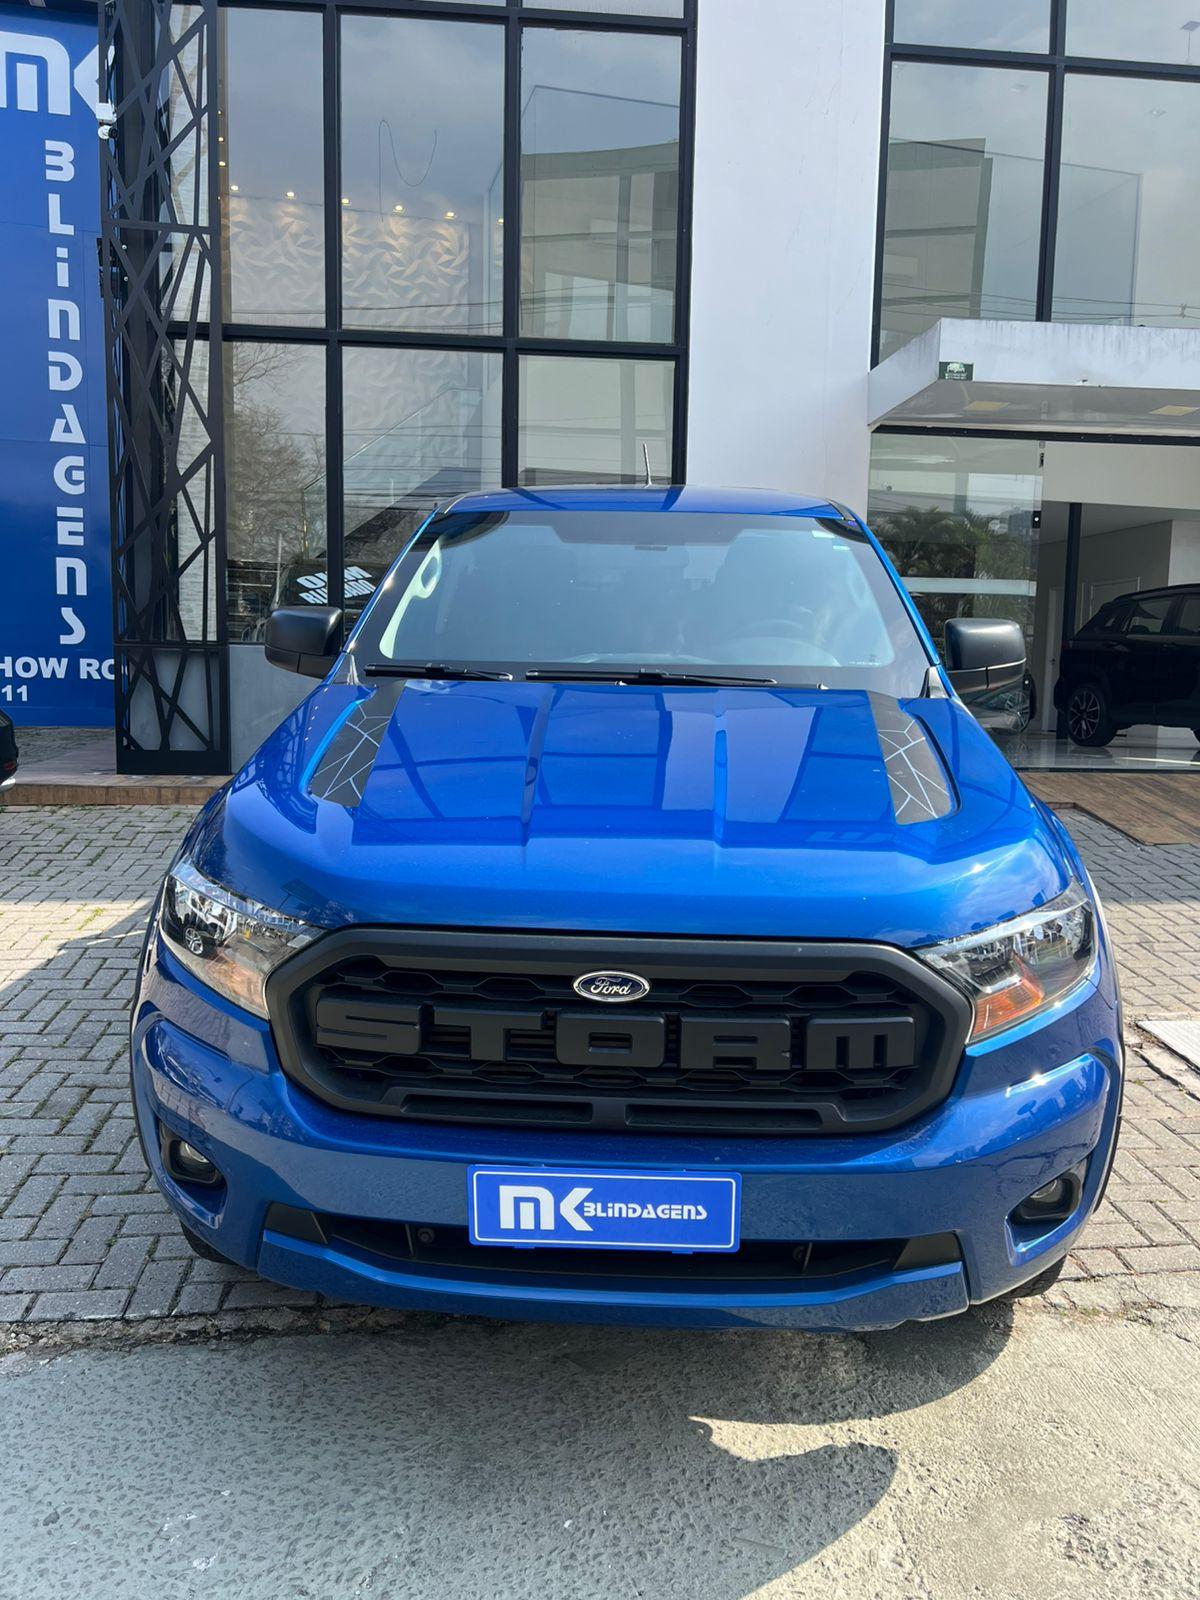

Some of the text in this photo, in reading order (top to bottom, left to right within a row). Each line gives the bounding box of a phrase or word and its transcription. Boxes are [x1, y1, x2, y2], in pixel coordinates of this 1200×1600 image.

[79, 658, 127, 681] RO
[1, 684, 28, 701] 11
[590, 976, 633, 995] Ford
[316, 999, 916, 1071] STORM
[499, 1185, 593, 1231] MK
